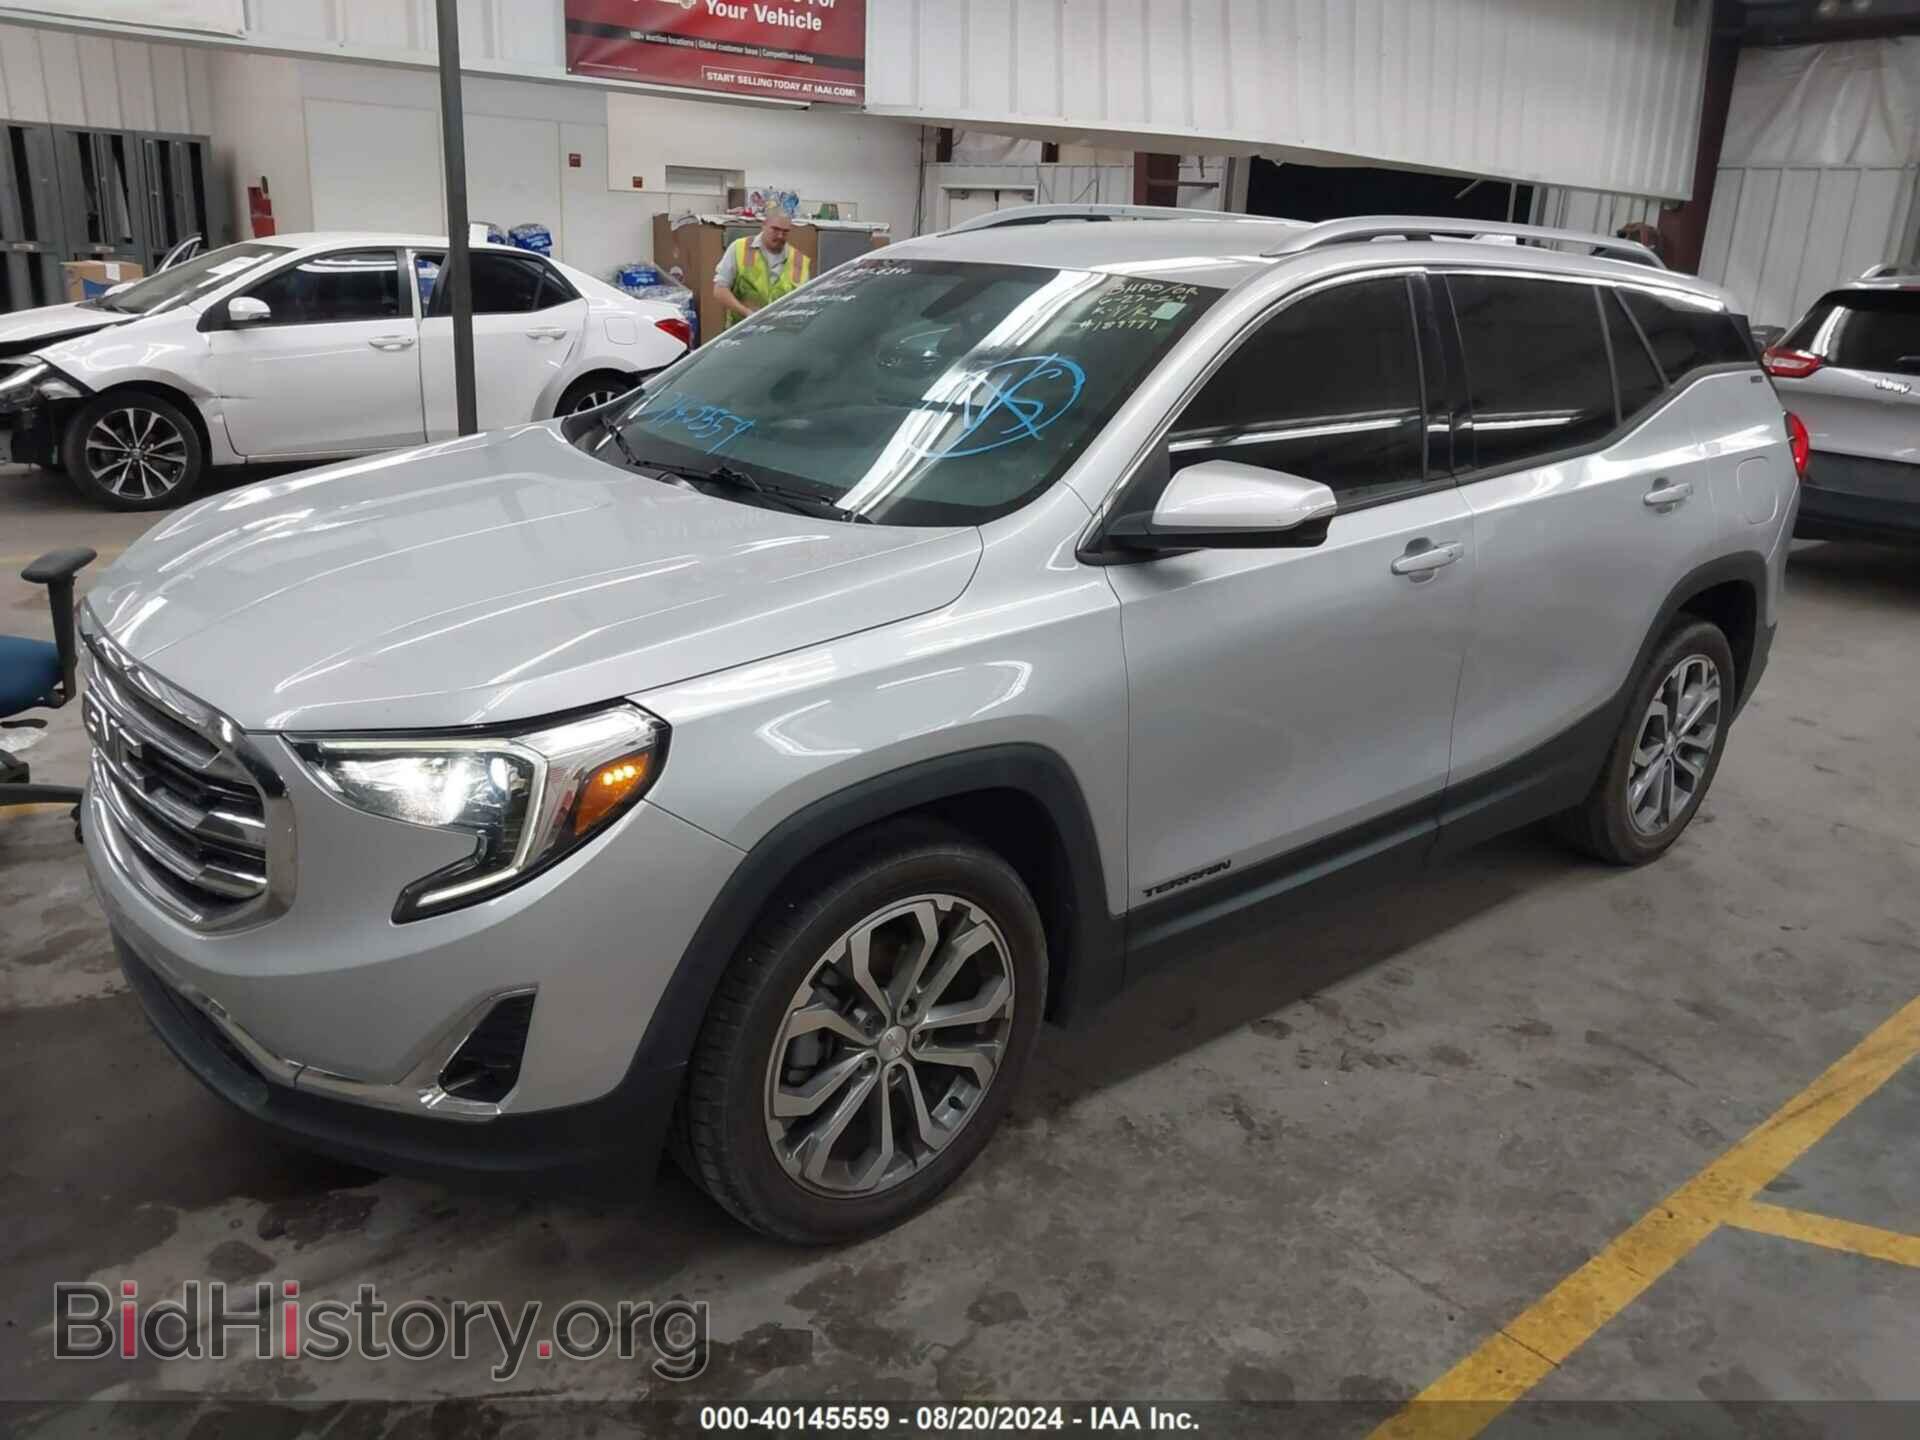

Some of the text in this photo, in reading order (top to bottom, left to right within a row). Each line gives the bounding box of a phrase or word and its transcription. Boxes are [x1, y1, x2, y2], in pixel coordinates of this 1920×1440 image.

[704, 0, 823, 31] Your Vehicle
[668, 36, 695, 48] locations
[706, 71, 735, 83] START
[737, 75, 773, 88] SELLING
[774, 79, 800, 91] TODAY
[802, 82, 812, 92] AT
